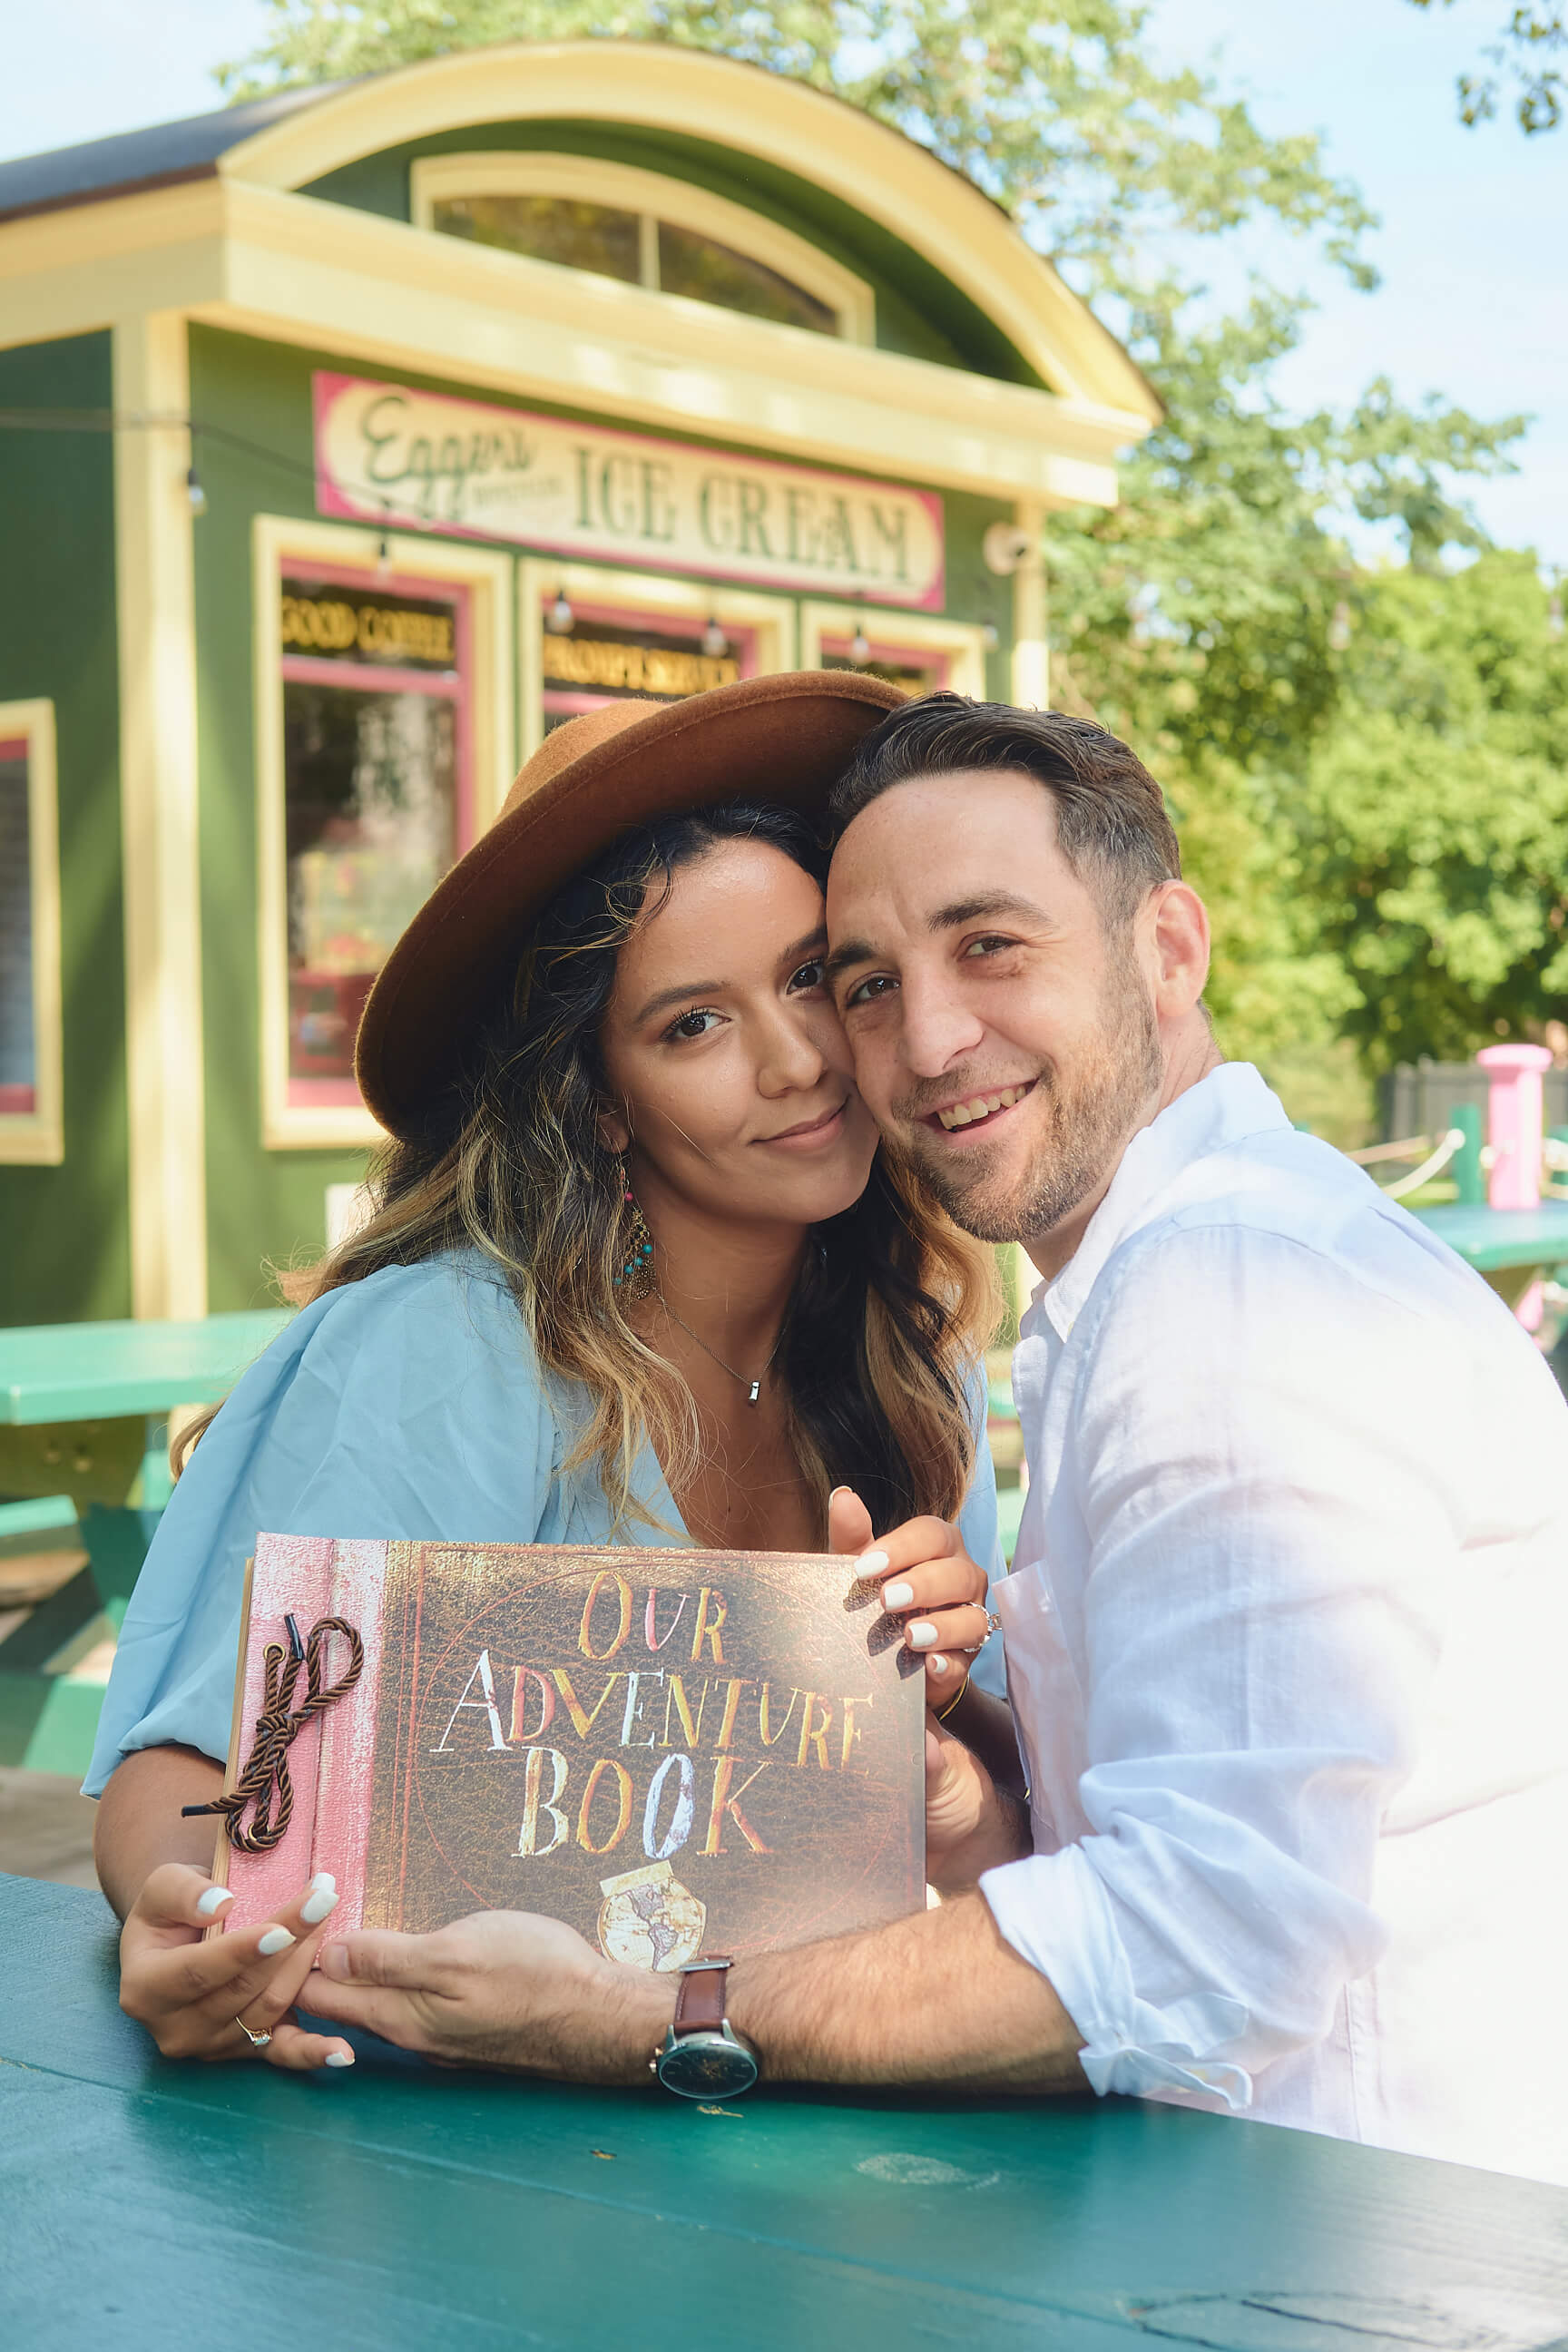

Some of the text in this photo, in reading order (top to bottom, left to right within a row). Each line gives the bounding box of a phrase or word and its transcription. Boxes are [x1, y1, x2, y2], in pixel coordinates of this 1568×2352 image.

[572, 445, 913, 586] ICE CREAM
[578, 1571, 729, 1665] OUR
[428, 1649, 875, 1778] ADVENTURE
[510, 1746, 775, 1859] BOOK
